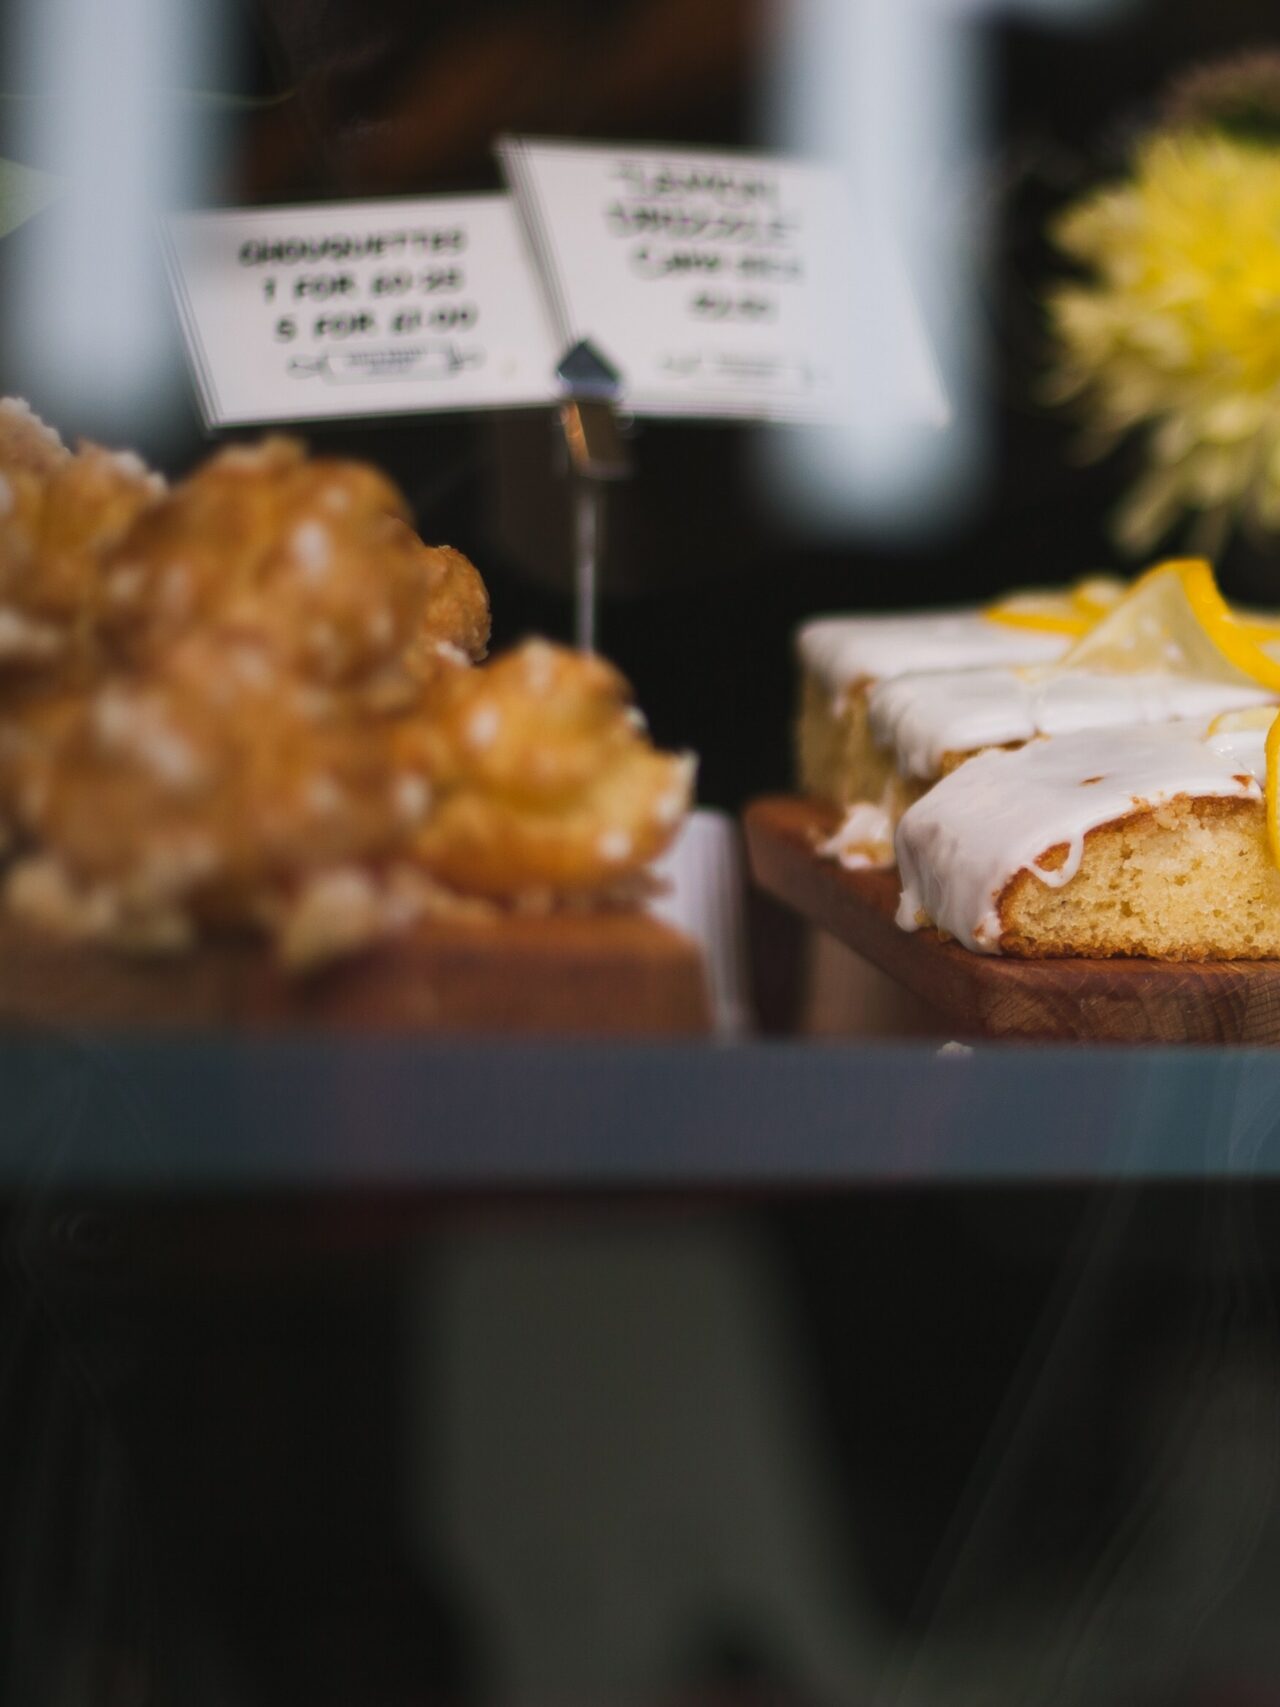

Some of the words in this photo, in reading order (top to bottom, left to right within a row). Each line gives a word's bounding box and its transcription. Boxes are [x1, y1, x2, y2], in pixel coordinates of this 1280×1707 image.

[293, 271, 355, 300] FOR
[274, 313, 298, 342] 5
[313, 306, 376, 339] FOR
